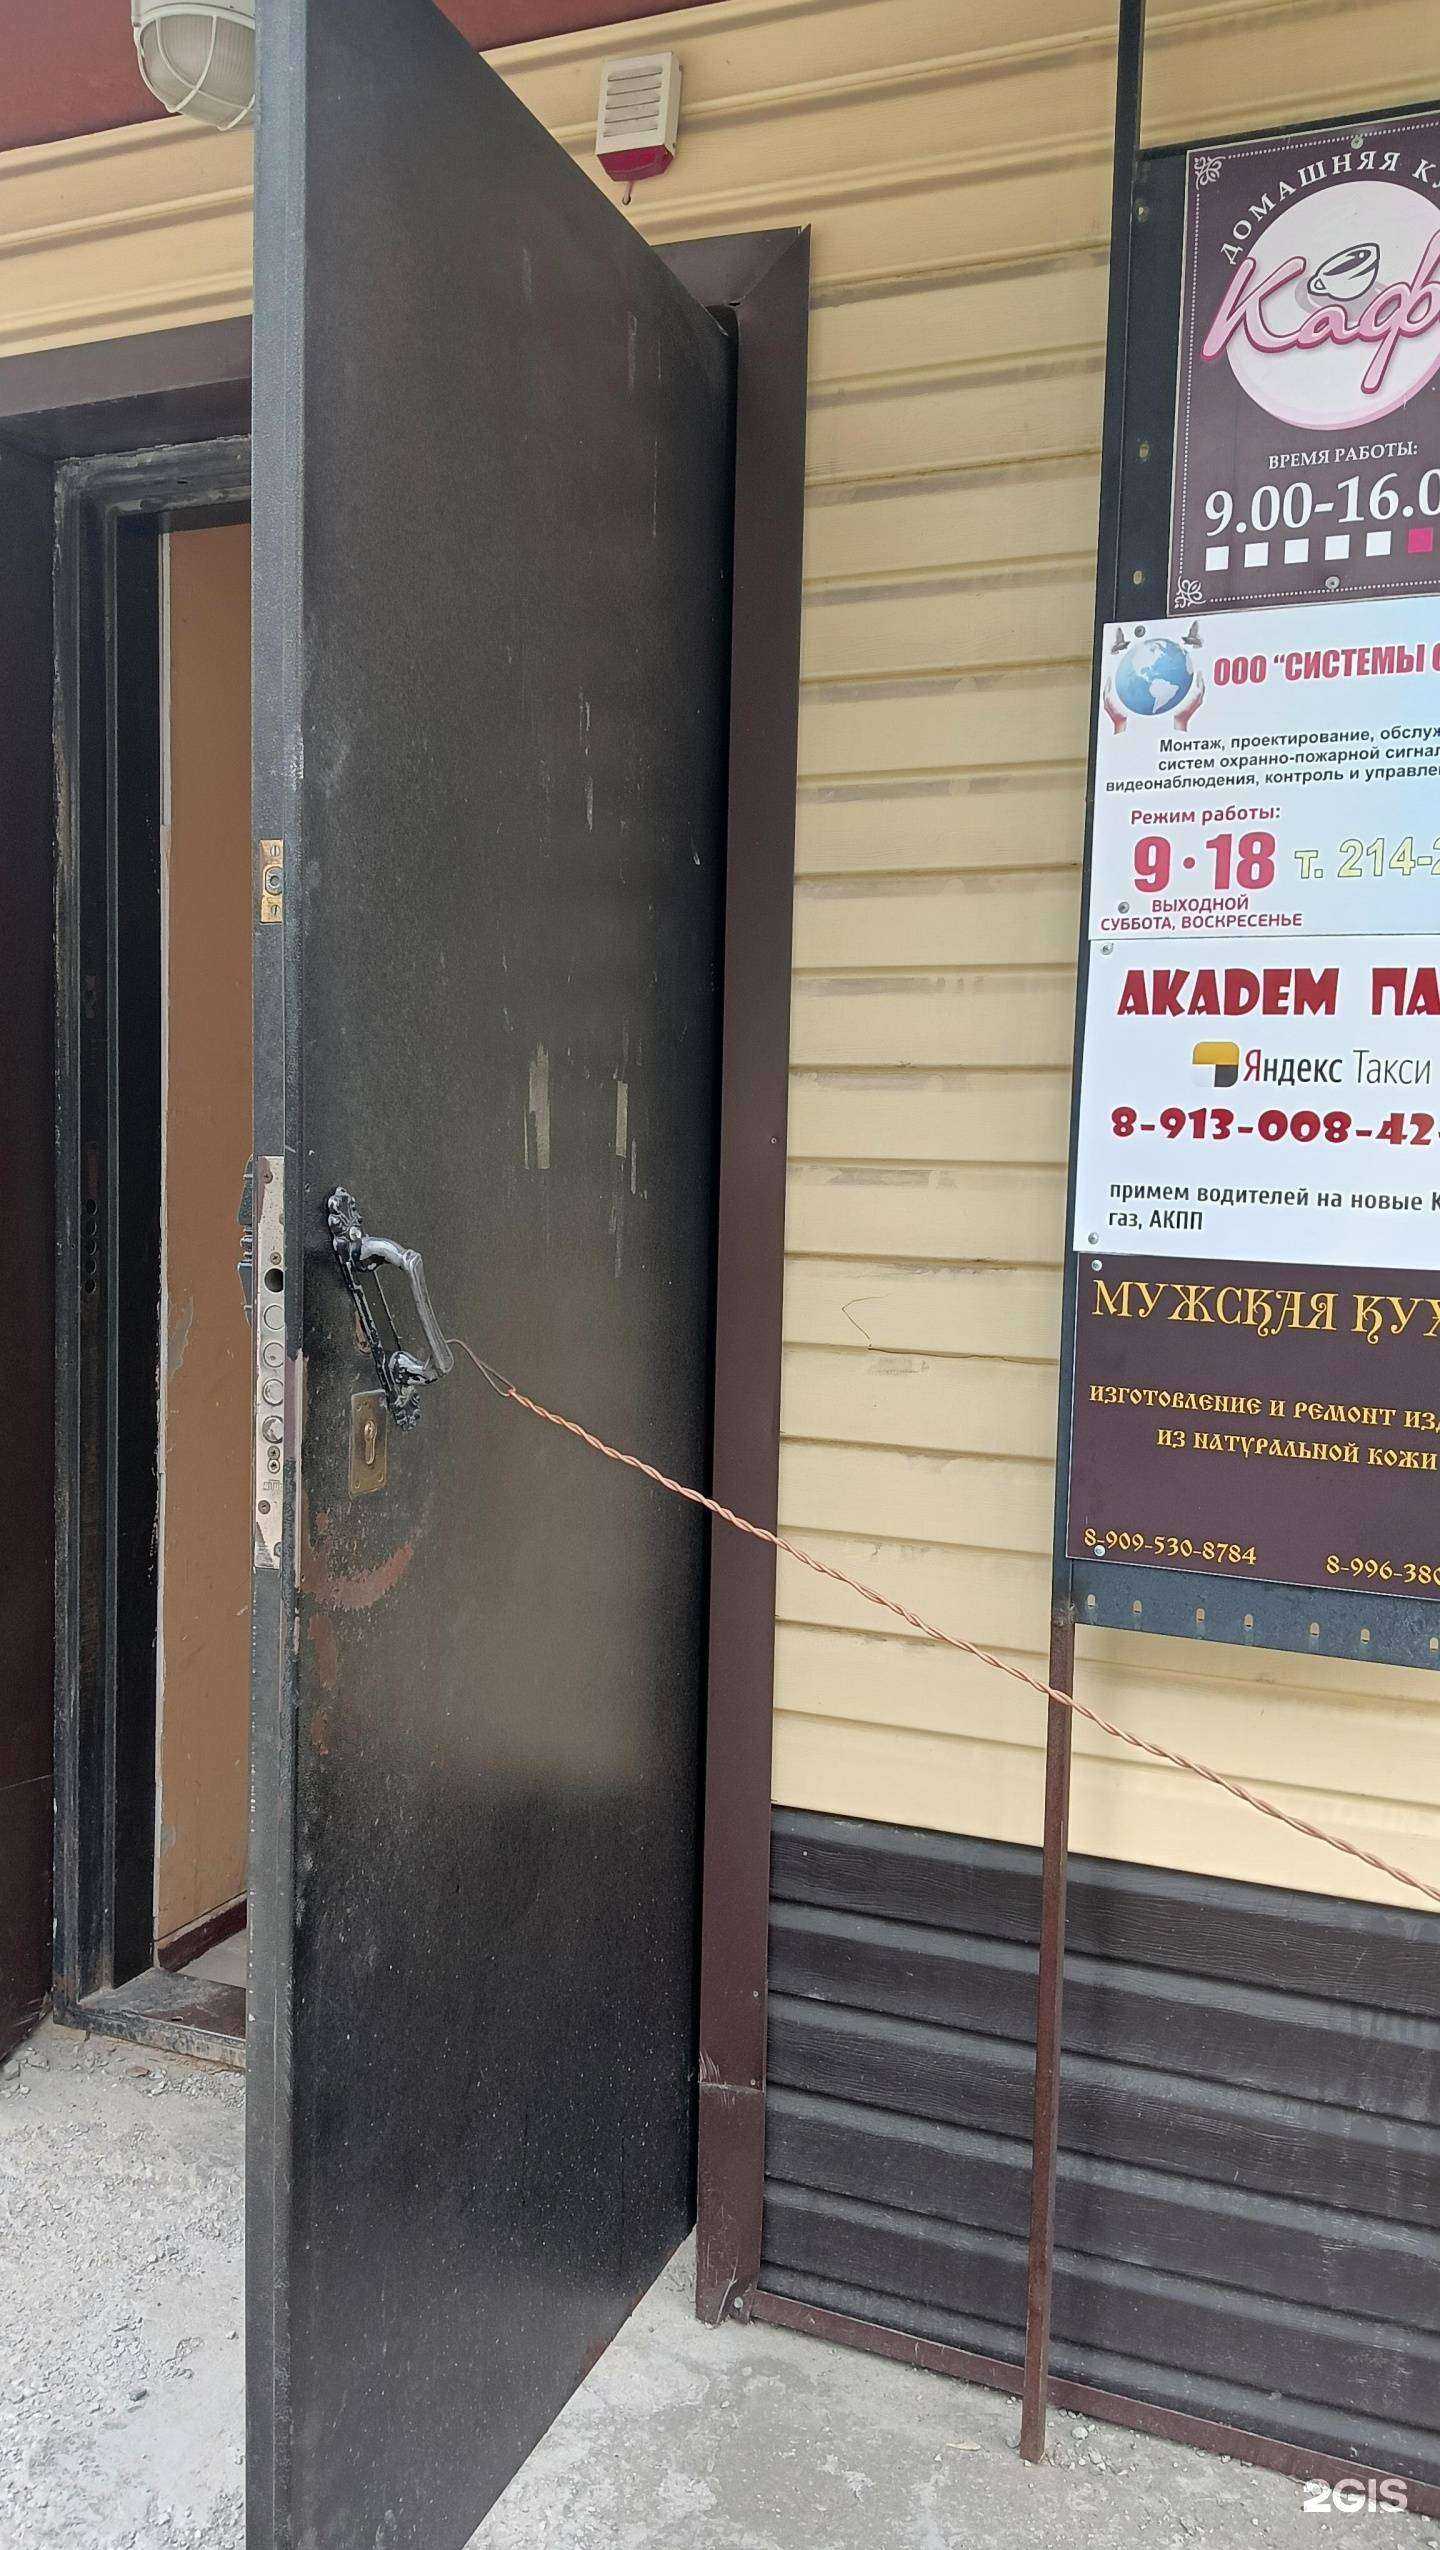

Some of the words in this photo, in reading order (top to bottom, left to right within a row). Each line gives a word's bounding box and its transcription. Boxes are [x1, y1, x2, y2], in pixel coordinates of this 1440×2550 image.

[1221, 150, 1399, 265] ДОМАШНЯЯ
[1411, 157, 1440, 189] К
[1268, 450, 1330, 470] ВРЕМЯ
[1334, 441, 1418, 465] РАБОТЫ:
[1205, 468, 1440, 537] 9.00-16.0
[1213, 655, 1267, 686] ООО
[1160, 738, 1226, 754] Монтаж,
[1231, 731, 1375, 751] проектирование,
[1158, 756, 1215, 771] систем
[1220, 747, 1380, 769] охранно-пожарной
[1106, 775, 1260, 793] видеонаблюдения,
[1265, 770, 1343, 786] контроль
[1349, 769, 1360, 780] и
[1365, 766, 1440, 783] управле
[1130, 810, 1195, 826] Режим
[1201, 805, 1281, 827] работы:
[1152, 894, 1249, 913] ВЫХОДНОЙ
[1101, 915, 1176, 931] СУББОТА,
[1181, 912, 1303, 929] ВОСКРЕСЕНЬЕ
[1371, 967, 1440, 1016] ПА
[1243, 1049, 1343, 1086] Яндекс
[1352, 1049, 1433, 1085] Такси
[1110, 1183, 1189, 1203] примем
[1197, 1186, 1309, 1207] водителей
[1317, 1192, 1342, 1208] на
[1351, 1194, 1423, 1211] новые
[1108, 1212, 1143, 1230] газ,
[1149, 1210, 1204, 1230] АКПП
[1092, 1279, 1339, 1338] МУЖСКАЯ
[1089, 1384, 1262, 1416] ИЗГОТОВЛЕНИЕ
[1269, 1398, 1286, 1418] И
[1293, 1401, 1397, 1426] РЕМОНТ
[1157, 1428, 1186, 1449] ИЗ
[1193, 1431, 1360, 1464] НАТУРАЛЬНОЙ
[1367, 1446, 1438, 1471] КОЖИ
[1084, 1527, 1257, 1566] 8-909-530-8784
